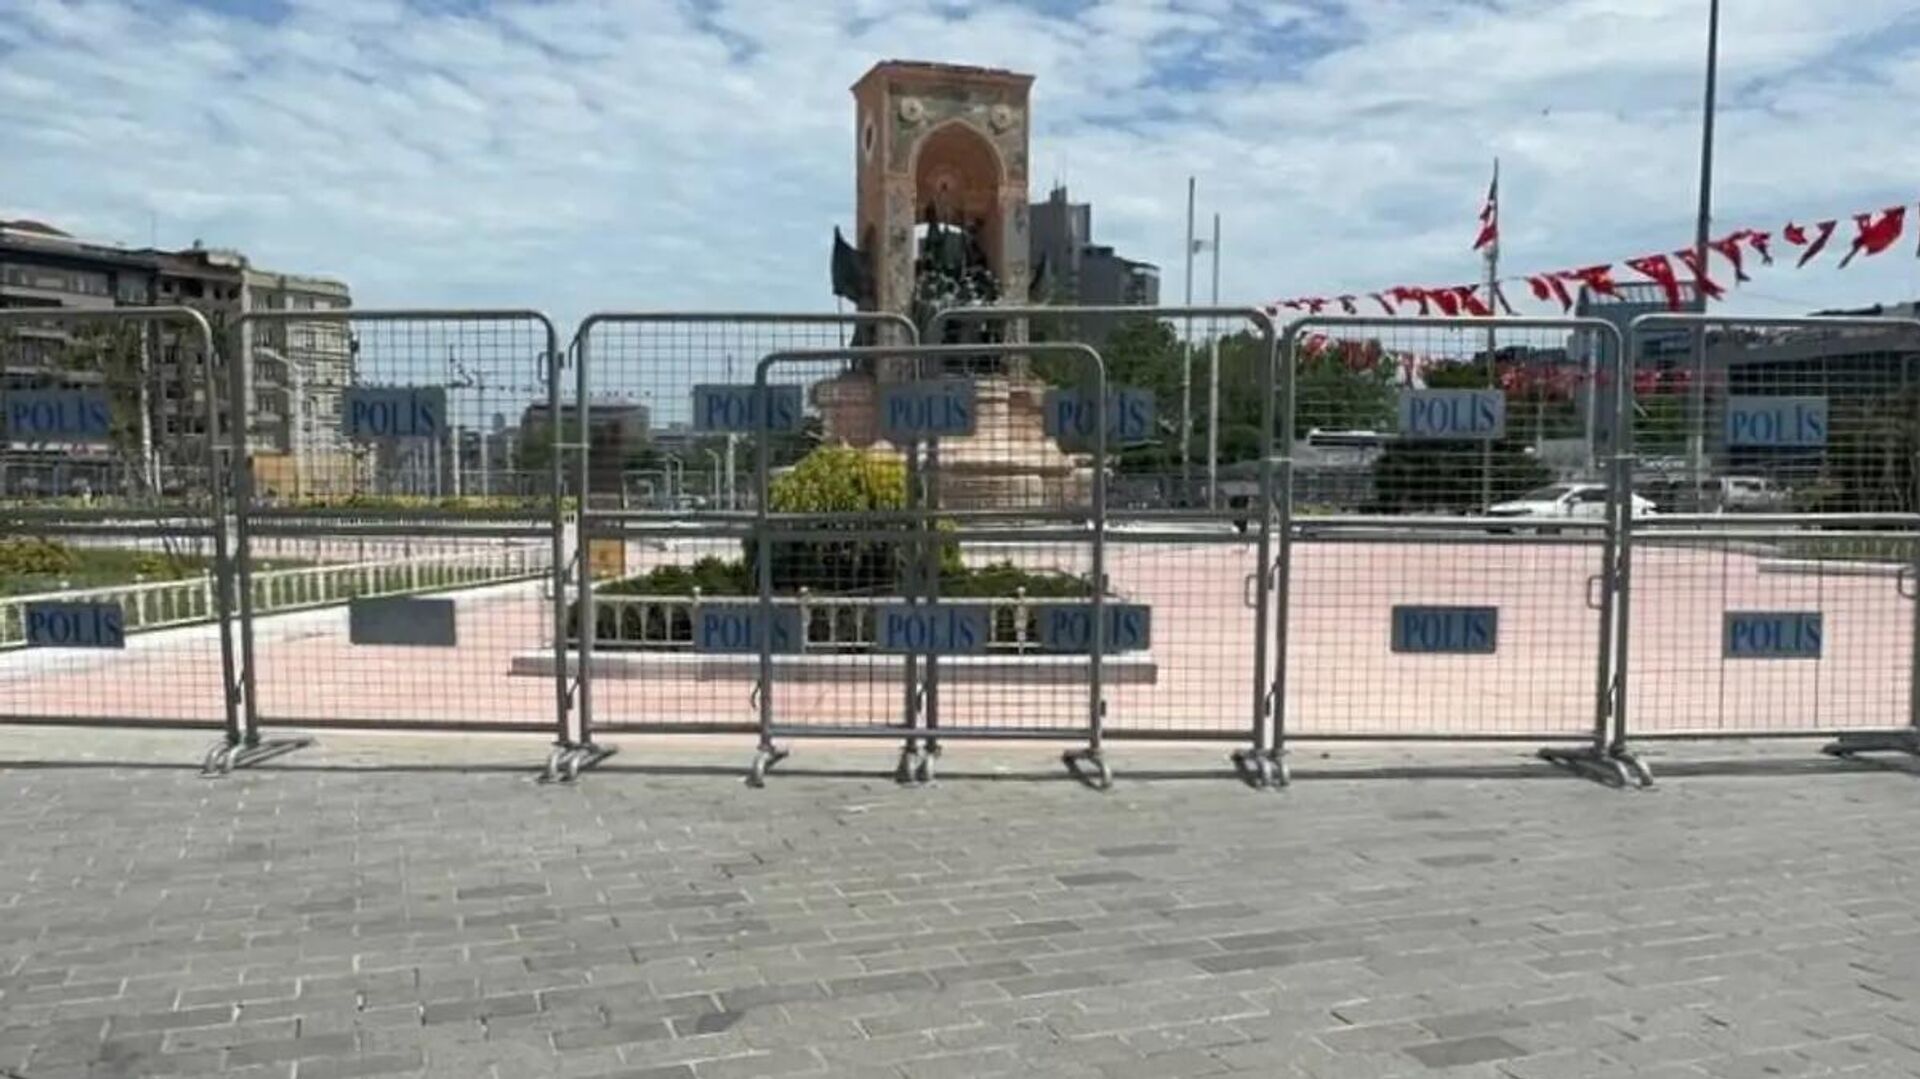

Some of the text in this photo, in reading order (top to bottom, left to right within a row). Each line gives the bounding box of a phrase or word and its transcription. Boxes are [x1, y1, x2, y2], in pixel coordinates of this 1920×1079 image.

[14, 396, 104, 432] POLİS
[353, 391, 434, 436] POLİS
[892, 387, 967, 428] POLİS
[1058, 392, 1143, 436] POİS
[1411, 393, 1494, 430] POLİS
[1734, 404, 1822, 439] POLİS
[30, 608, 118, 644] POLİS
[706, 612, 787, 648] POLS
[889, 609, 973, 647] POLİS
[1054, 608, 1139, 644] POİS
[1404, 610, 1486, 648] POLİS
[1733, 614, 1819, 651] POLİS
